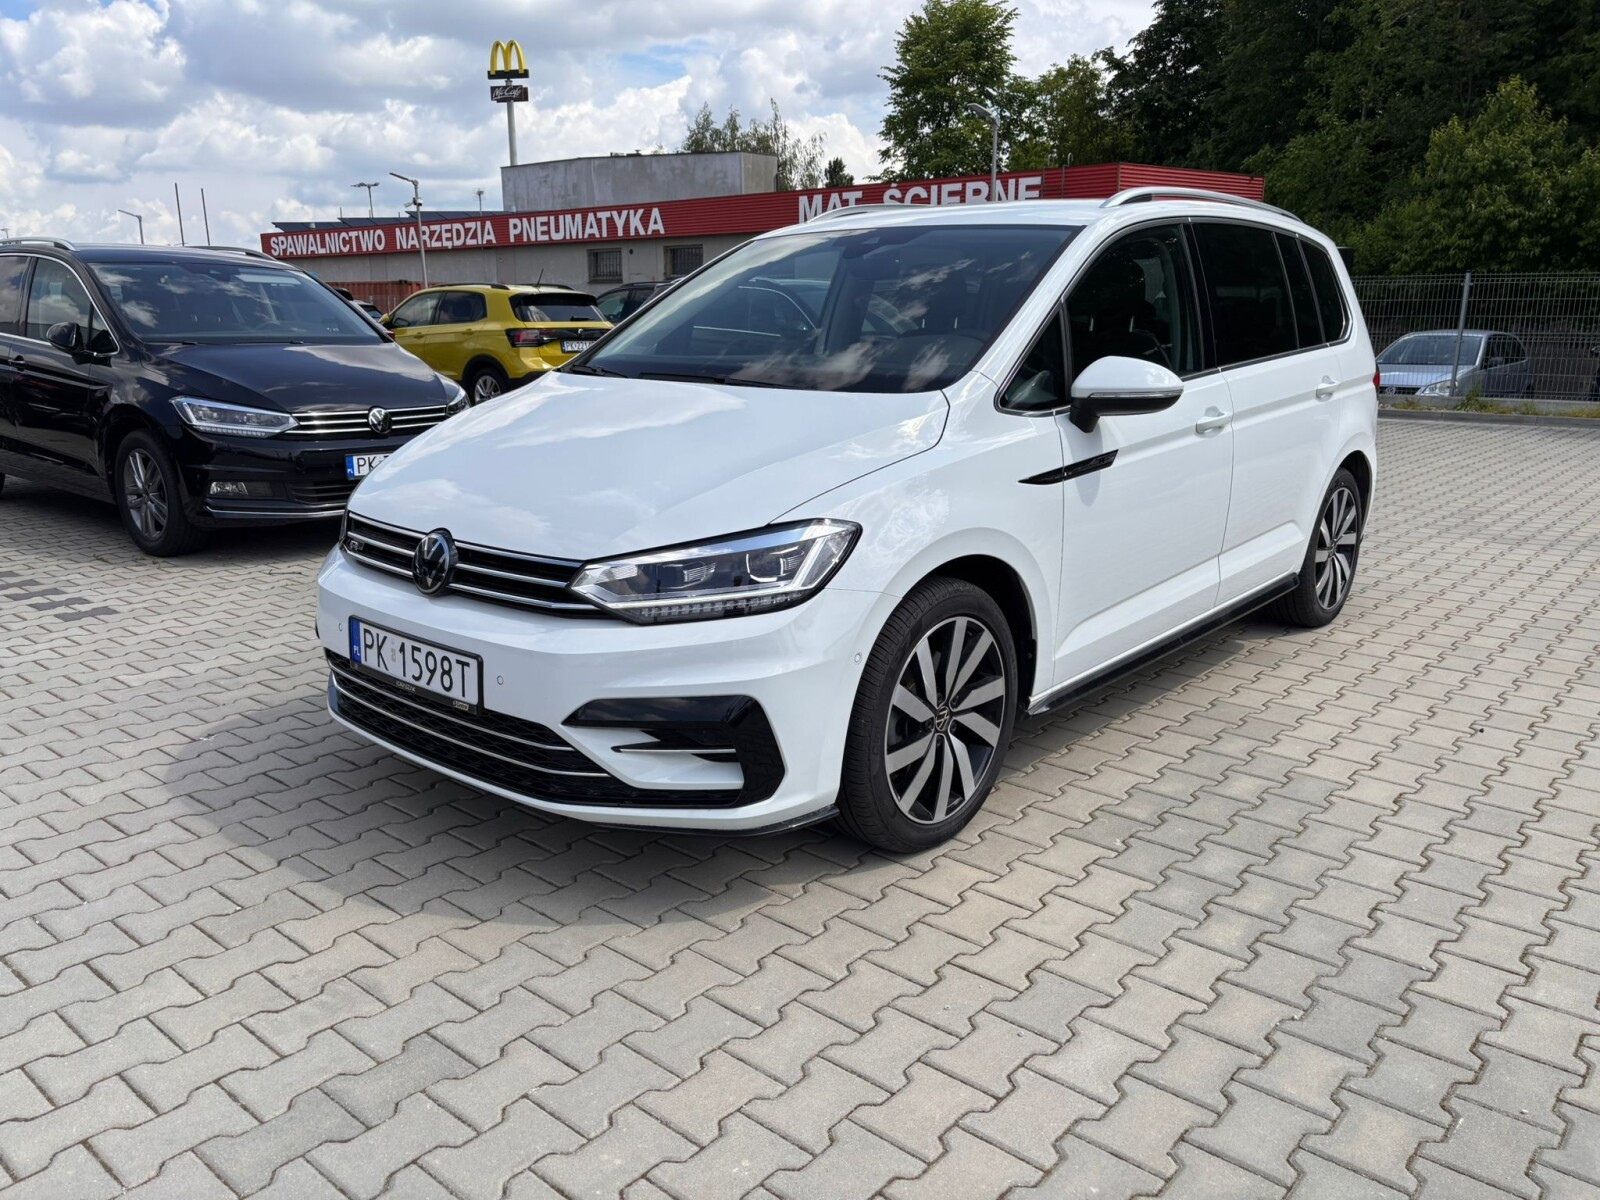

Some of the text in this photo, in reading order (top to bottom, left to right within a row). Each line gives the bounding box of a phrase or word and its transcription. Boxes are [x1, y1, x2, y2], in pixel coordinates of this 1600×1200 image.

[270, 207, 665, 256] SPAWALNICTWO NARZĘDZIA PNEUMATYKA
[353, 645, 361, 656] PL
[363, 628, 470, 698] PK 1598T
